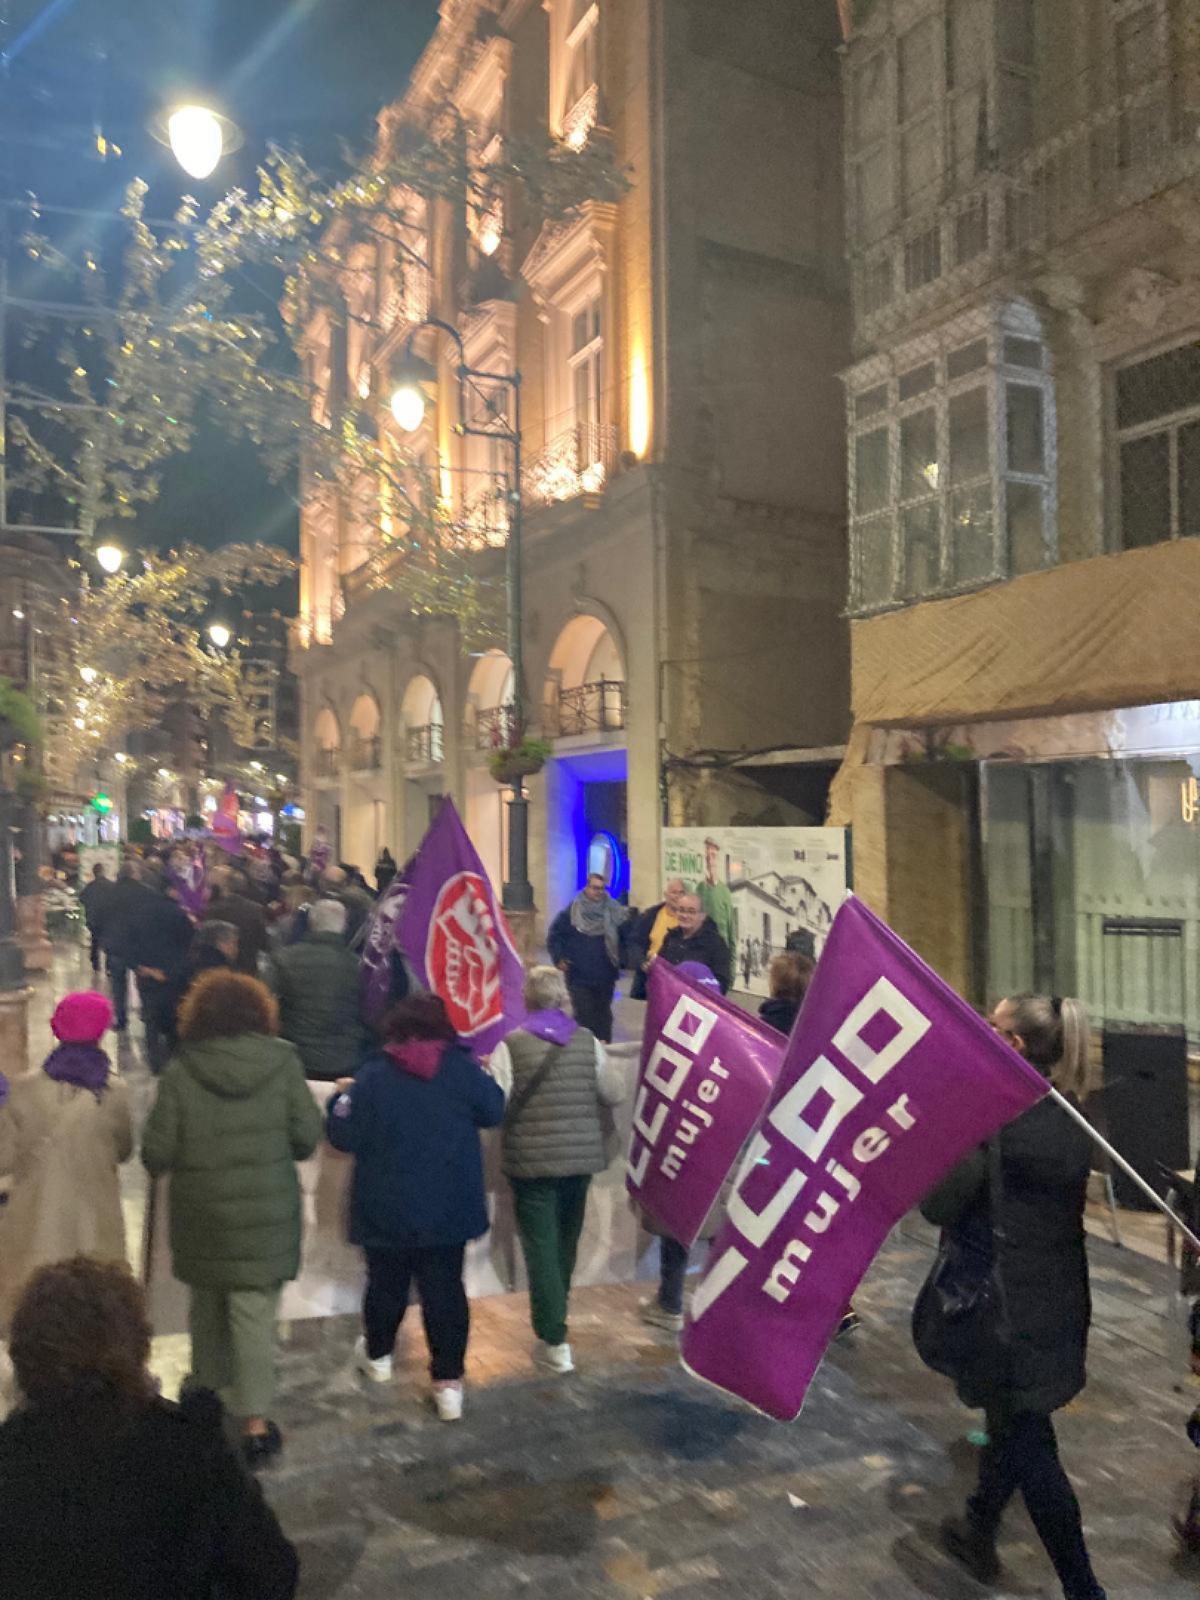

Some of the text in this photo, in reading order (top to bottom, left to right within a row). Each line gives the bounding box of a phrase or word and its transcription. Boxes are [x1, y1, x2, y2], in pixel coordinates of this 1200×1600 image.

[627, 994, 717, 1189] CCOO
[660, 1056, 731, 1180] mujer
[762, 1093, 921, 1303] mujer
